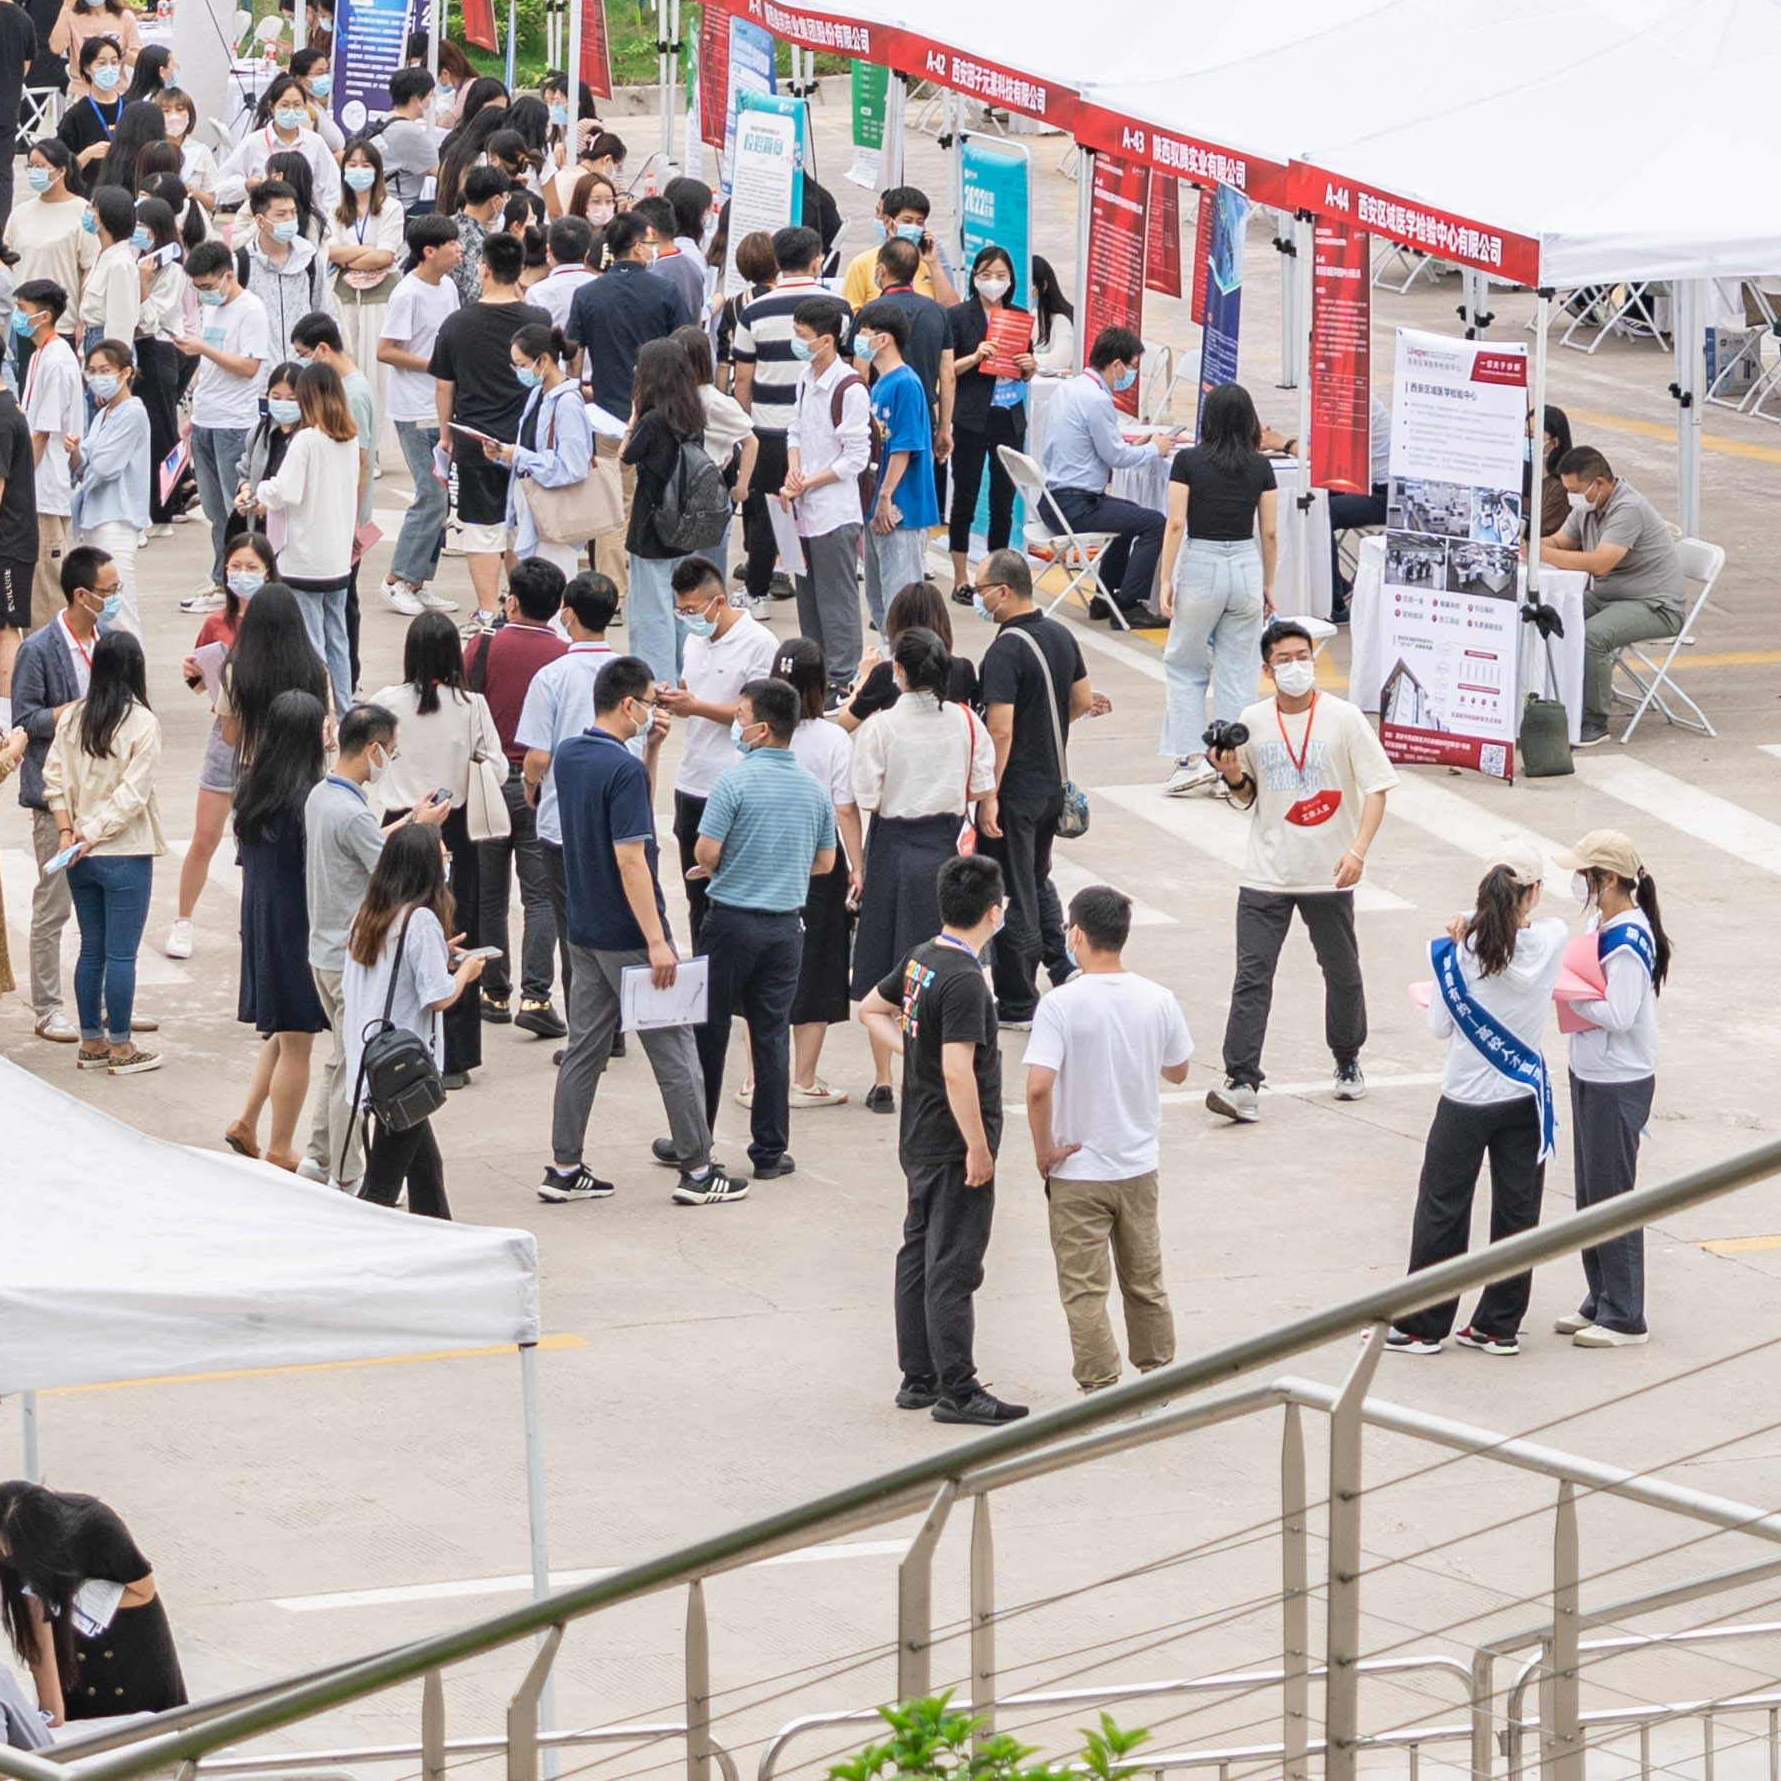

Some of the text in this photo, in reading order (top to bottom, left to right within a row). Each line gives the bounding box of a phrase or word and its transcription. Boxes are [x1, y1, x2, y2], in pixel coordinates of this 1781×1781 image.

[925, 50, 947, 76] A-42
[1122, 126, 1145, 153] A-43
[1324, 182, 1503, 267] A-44 西安区域医学检验中心有限公司
[1410, 382, 1477, 402] 西安区域医学检验中心
